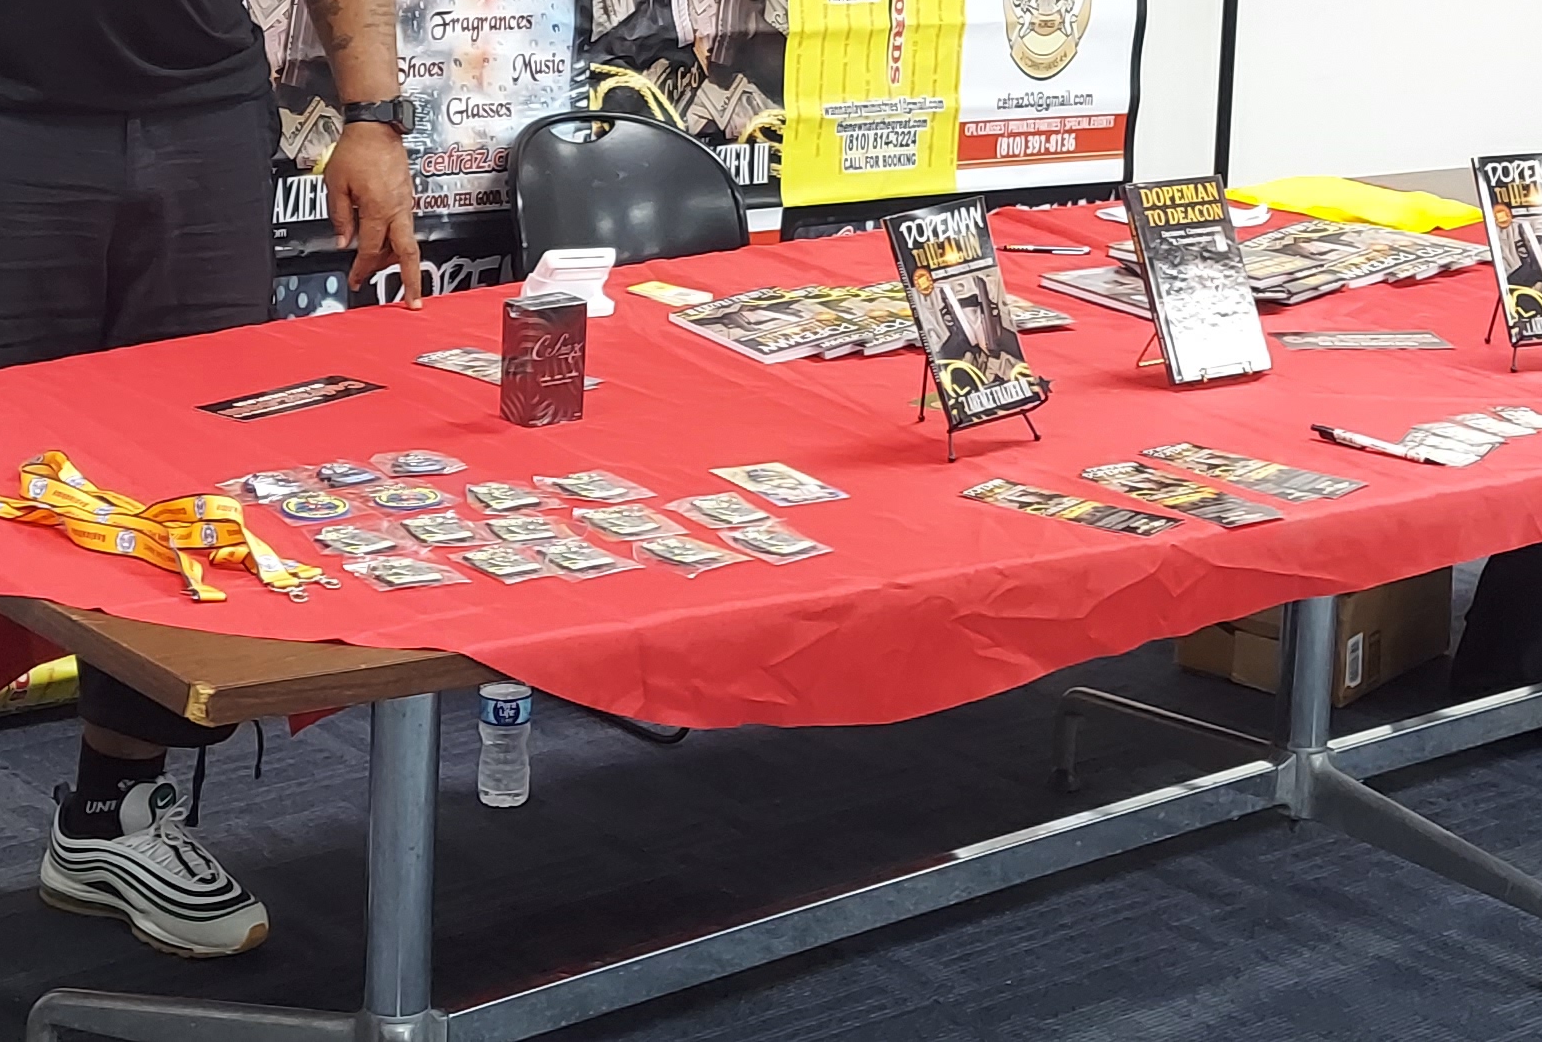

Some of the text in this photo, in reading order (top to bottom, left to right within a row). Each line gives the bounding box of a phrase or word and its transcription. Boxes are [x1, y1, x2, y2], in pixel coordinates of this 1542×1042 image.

[430, 10, 533, 41] Fragrances
[511, 52, 565, 85] Music
[447, 97, 512, 126] Glasses
[997, 91, 1093, 111] cefraz33@gmail.com
[844, 131, 917, 155] (810) 814-3224
[997, 133, 1076, 158] (810) 391-8136
[753, 143, 769, 184] III
[844, 154, 916, 170] CALL FOR BOOKING
[272, 173, 328, 223] AZIER
[424, 193, 450, 209] GOOD,
[453, 192, 473, 207] FEEL
[476, 190, 506, 206] GOOD,
[1139, 182, 1219, 208] DOPEMAN
[899, 200, 984, 249] DOPEMAN
[1145, 203, 1224, 226] TO DEACON
